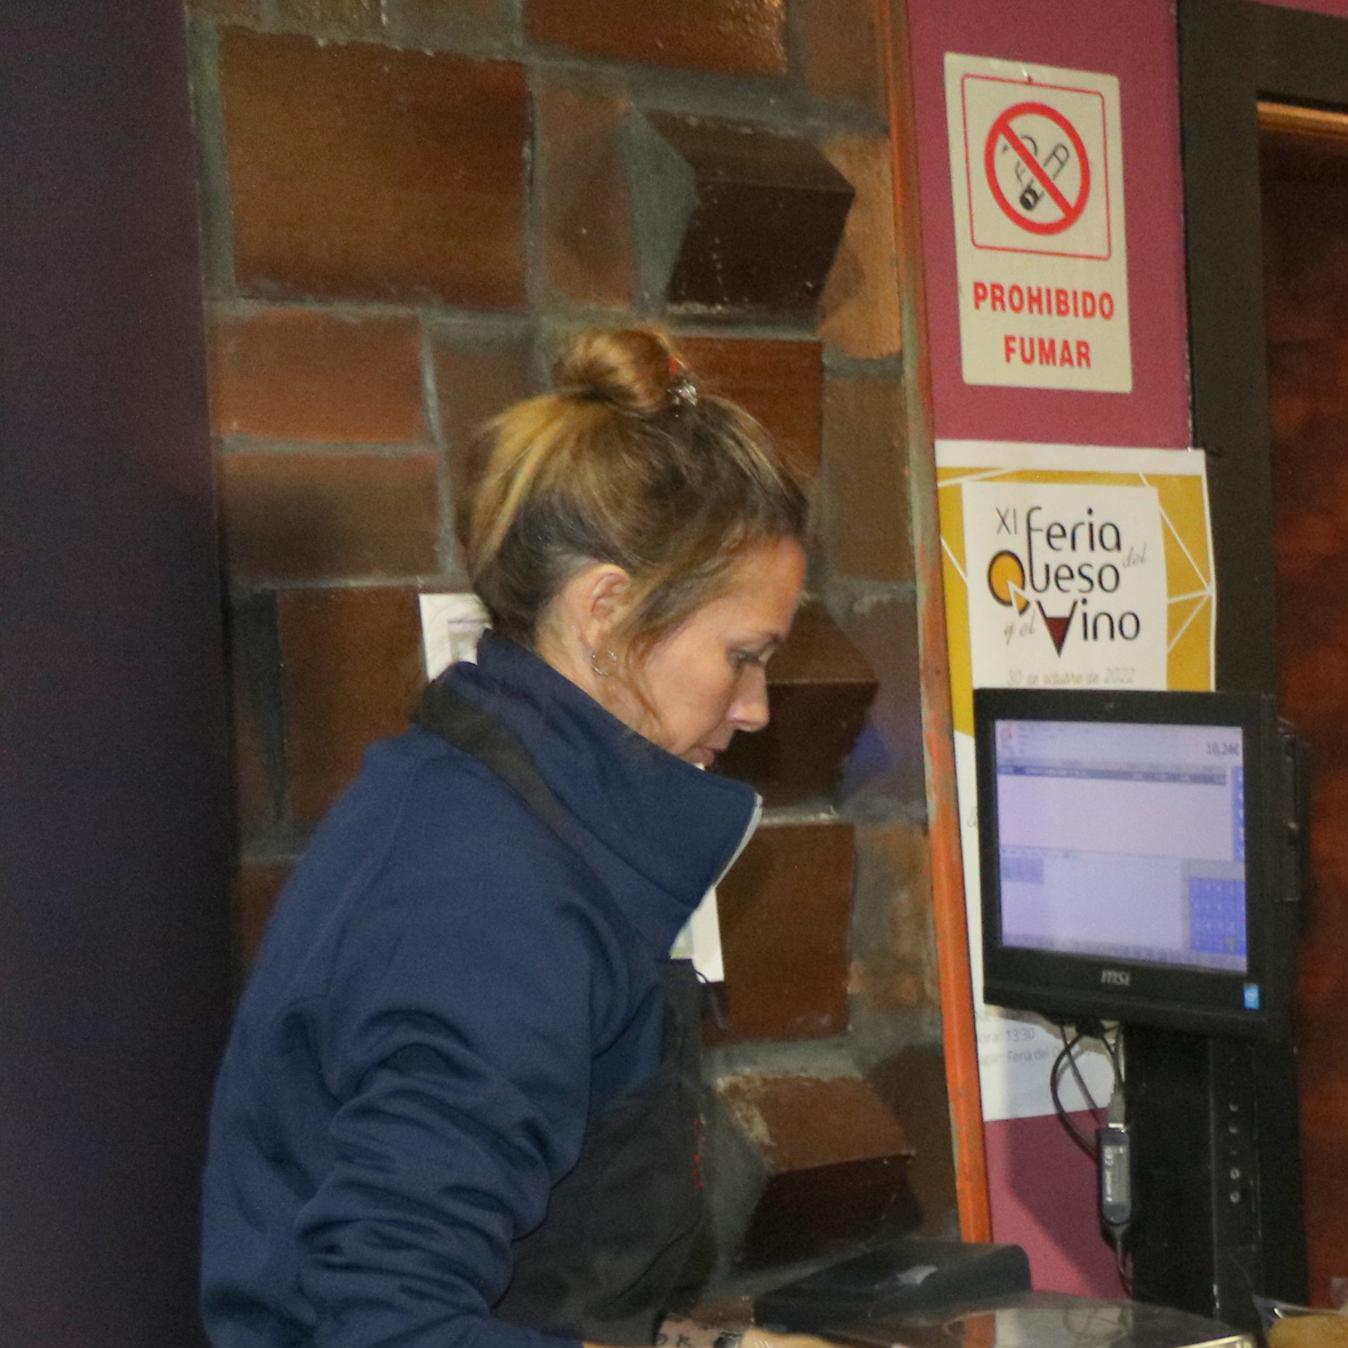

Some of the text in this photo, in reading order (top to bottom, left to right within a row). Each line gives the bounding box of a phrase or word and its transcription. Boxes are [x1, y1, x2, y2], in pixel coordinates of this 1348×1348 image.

[973, 281, 1115, 320] PROHIBIDO
[1003, 335, 1092, 368] FUMAR
[996, 507, 1018, 536] XI
[987, 549, 1122, 617] Queso
[1036, 597, 1142, 658] Vino
